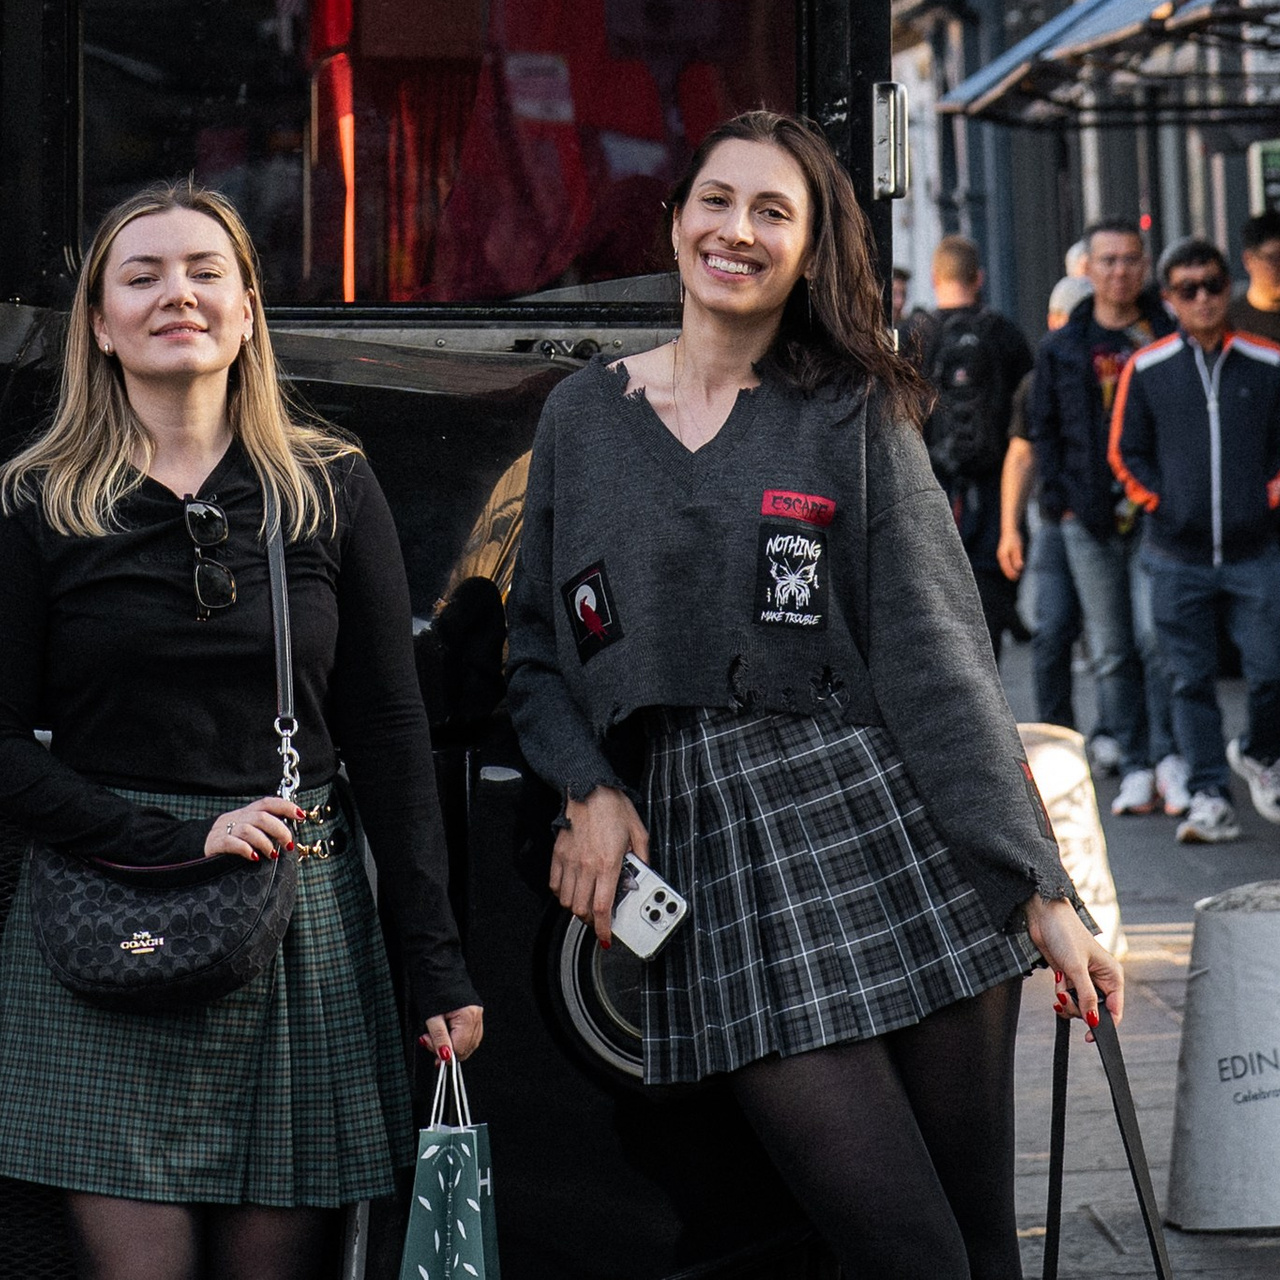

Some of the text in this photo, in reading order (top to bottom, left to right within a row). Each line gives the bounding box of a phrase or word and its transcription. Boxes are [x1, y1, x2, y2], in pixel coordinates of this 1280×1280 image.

[771, 495, 829, 520] ESCAPE
[765, 534, 822, 561] NOTHING
[760, 610, 823, 626] MAKE TROUBLE
[119, 937, 165, 950] COACH
